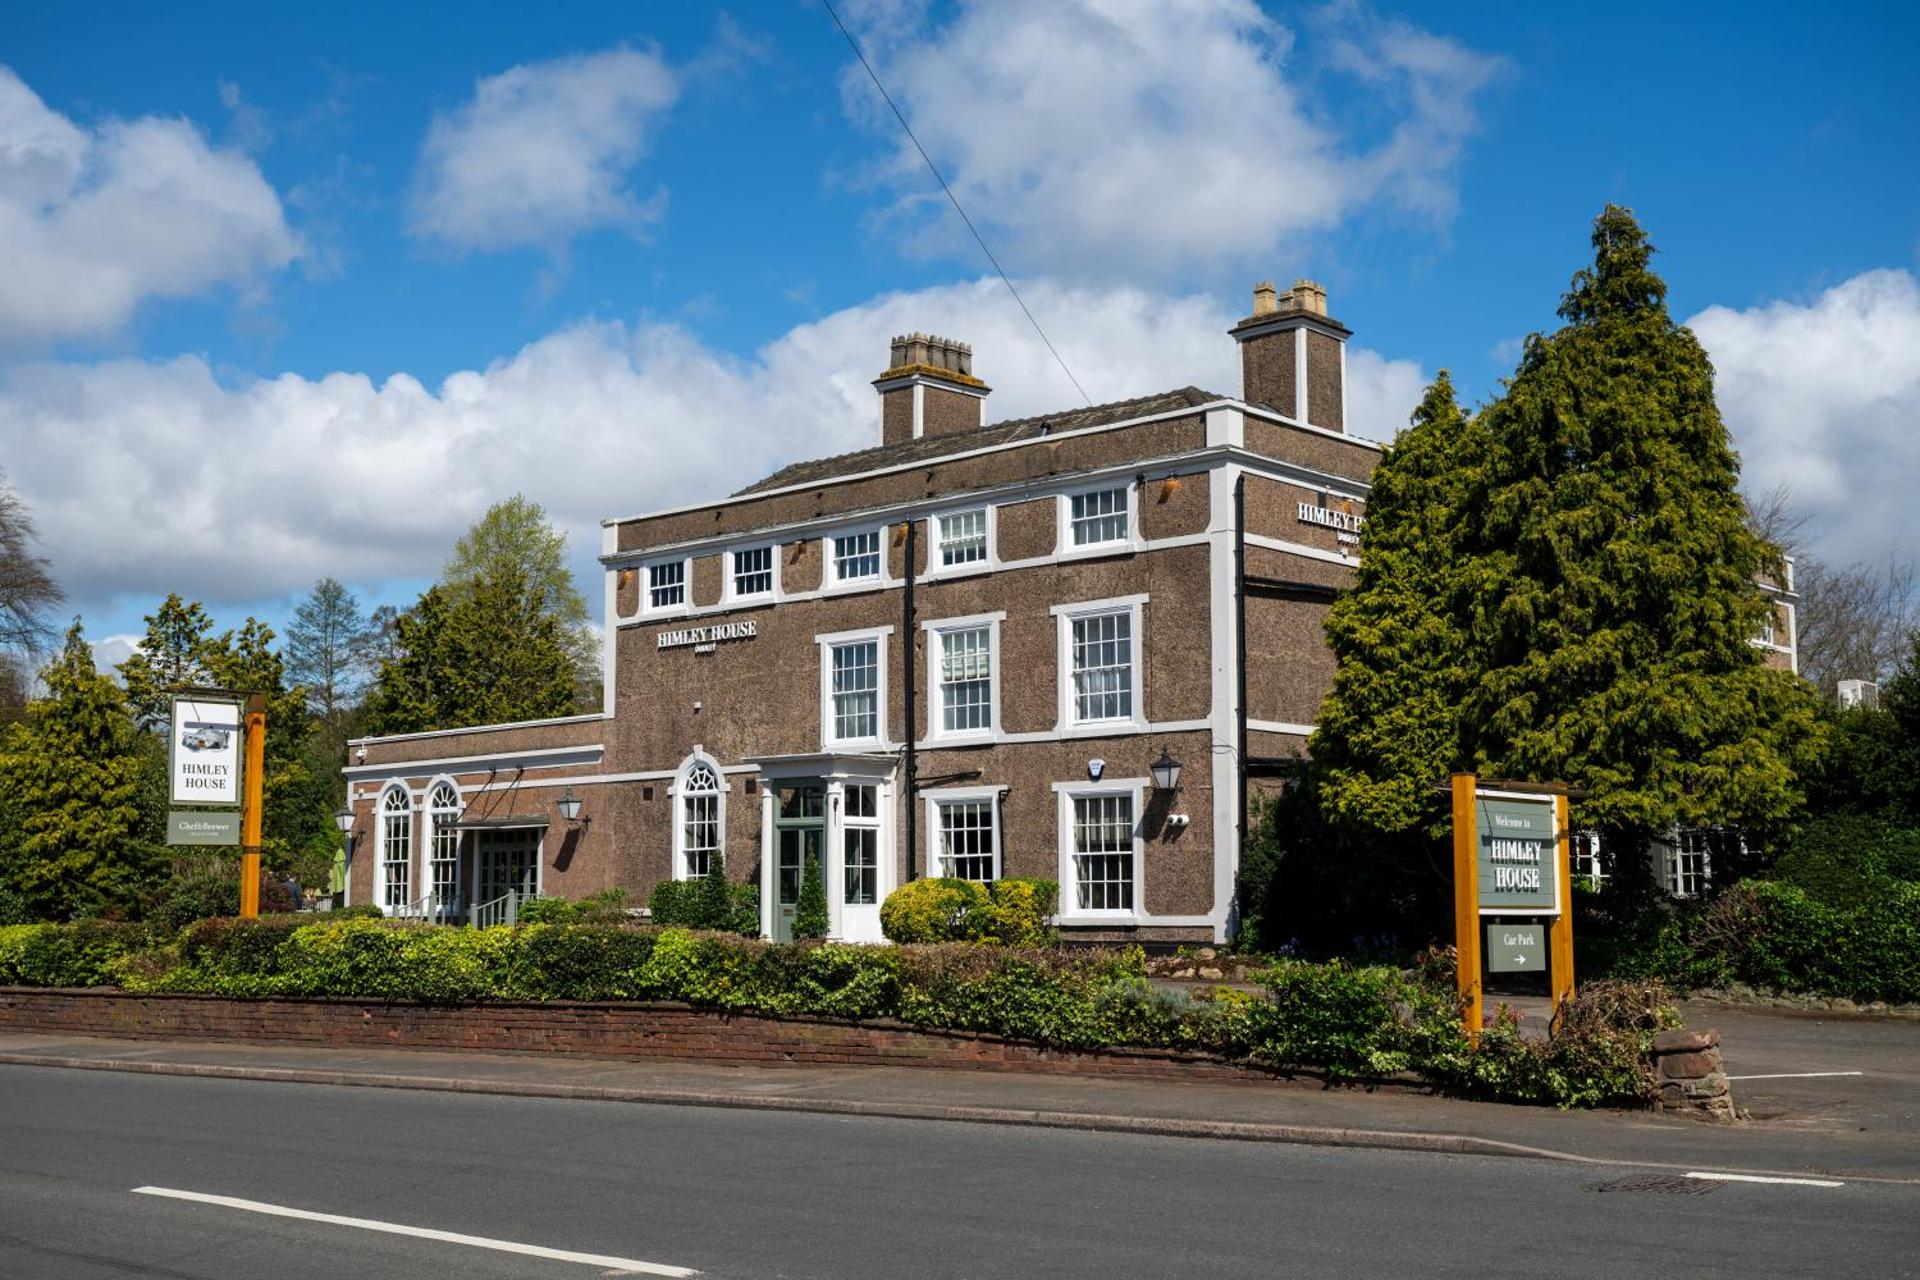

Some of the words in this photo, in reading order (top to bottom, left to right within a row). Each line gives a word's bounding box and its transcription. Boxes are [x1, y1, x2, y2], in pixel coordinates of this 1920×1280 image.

[1297, 502, 1351, 531] HIMLEY
[657, 627, 707, 647] HIMLEY
[710, 620, 757, 641] HOUSE
[182, 763, 229, 775] HIMLEY
[185, 778, 226, 789] HOUSE
[1495, 815, 1523, 828] Welcome
[1523, 819, 1531, 829] to
[1491, 840, 1542, 860] HIMLEY
[1495, 867, 1540, 888] HOUSE
[1503, 933, 1517, 946] Car
[1517, 933, 1534, 946] Park
